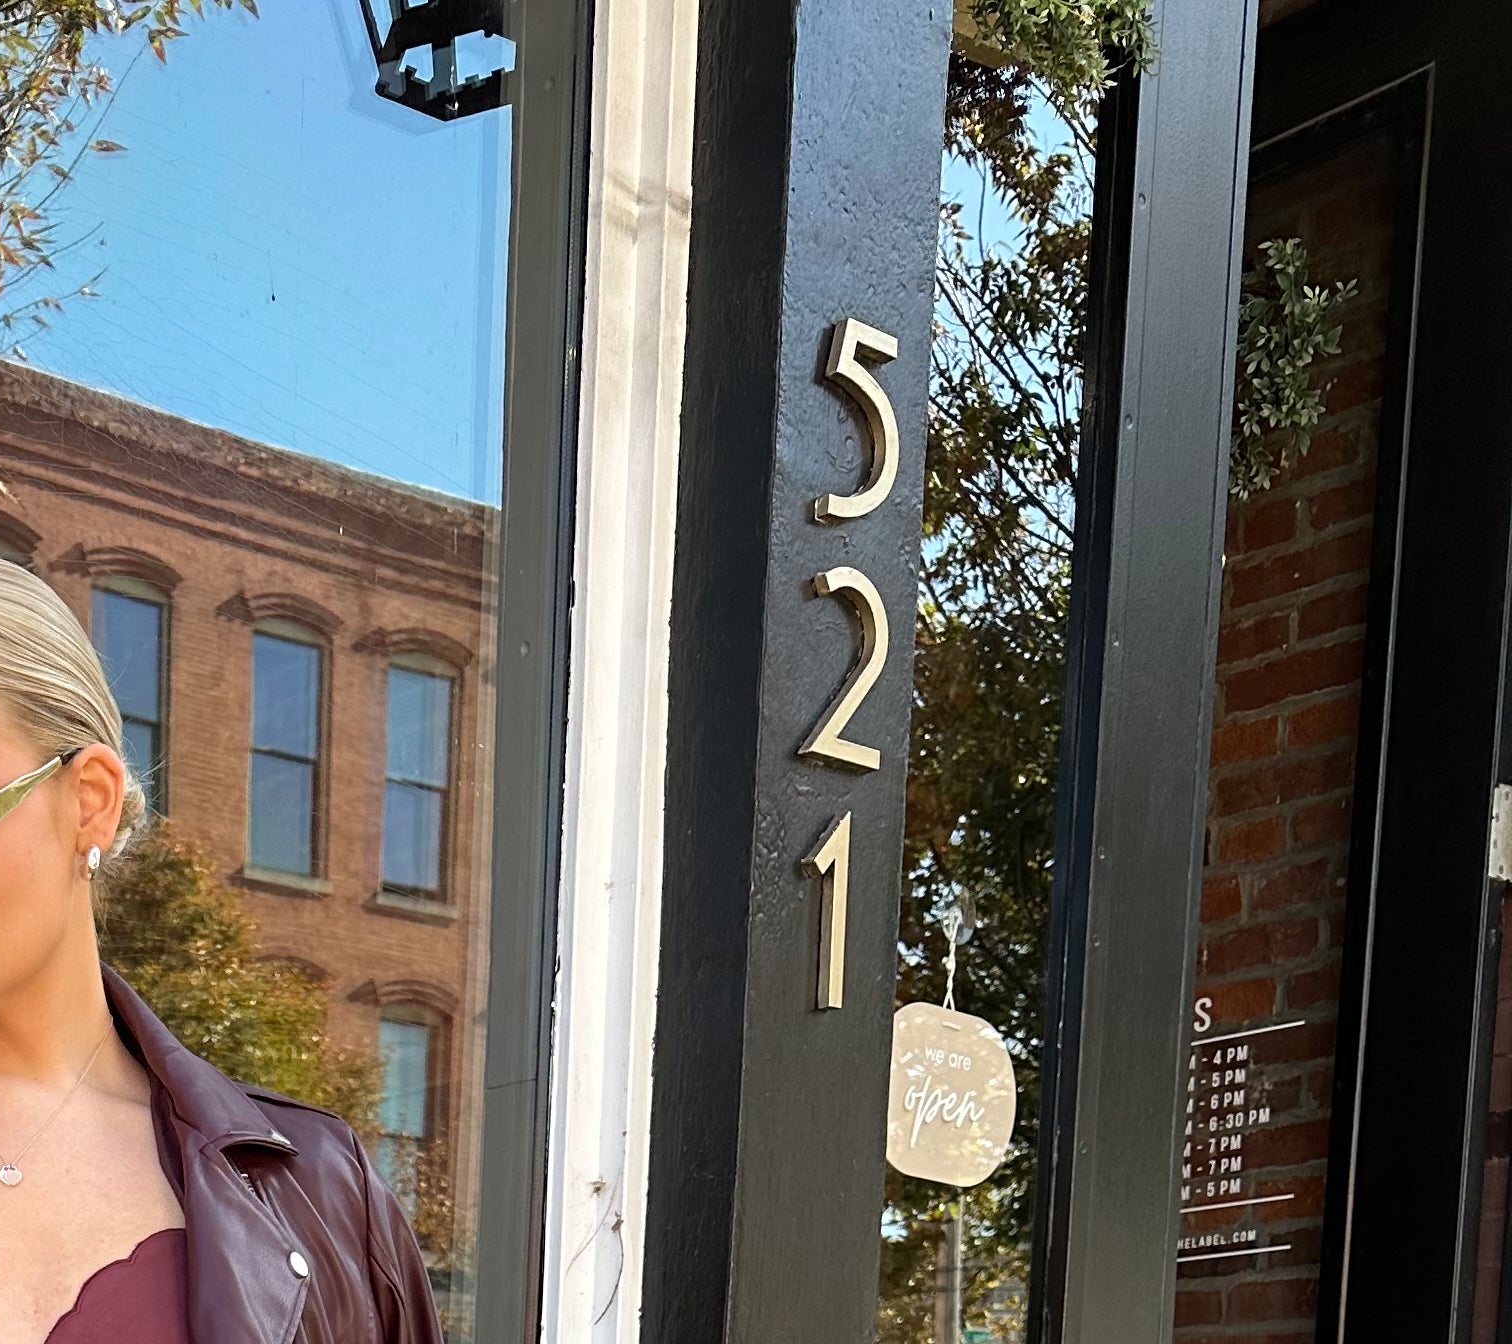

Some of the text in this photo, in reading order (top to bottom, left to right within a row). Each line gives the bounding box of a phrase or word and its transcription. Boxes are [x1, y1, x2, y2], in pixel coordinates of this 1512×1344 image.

[924, 1045, 972, 1071] we are
[1213, 1049, 1222, 1065] 4
[1226, 1045, 1248, 1063] PM
[1211, 1071, 1220, 1087] 5
[1224, 1068, 1246, 1085] PM
[1210, 1094, 1219, 1110] 6
[1223, 1089, 1245, 1108] PM
[904, 1075, 985, 1148] open
[1209, 1112, 1244, 1132] 6:30
[1248, 1107, 1270, 1125] PM
[1208, 1138, 1216, 1154] 7
[1220, 1133, 1242, 1152] PM
[1208, 1160, 1216, 1175] 7
[1220, 1155, 1242, 1174] PM
[1206, 1181, 1215, 1197] 5
[1219, 1177, 1241, 1196] PM
